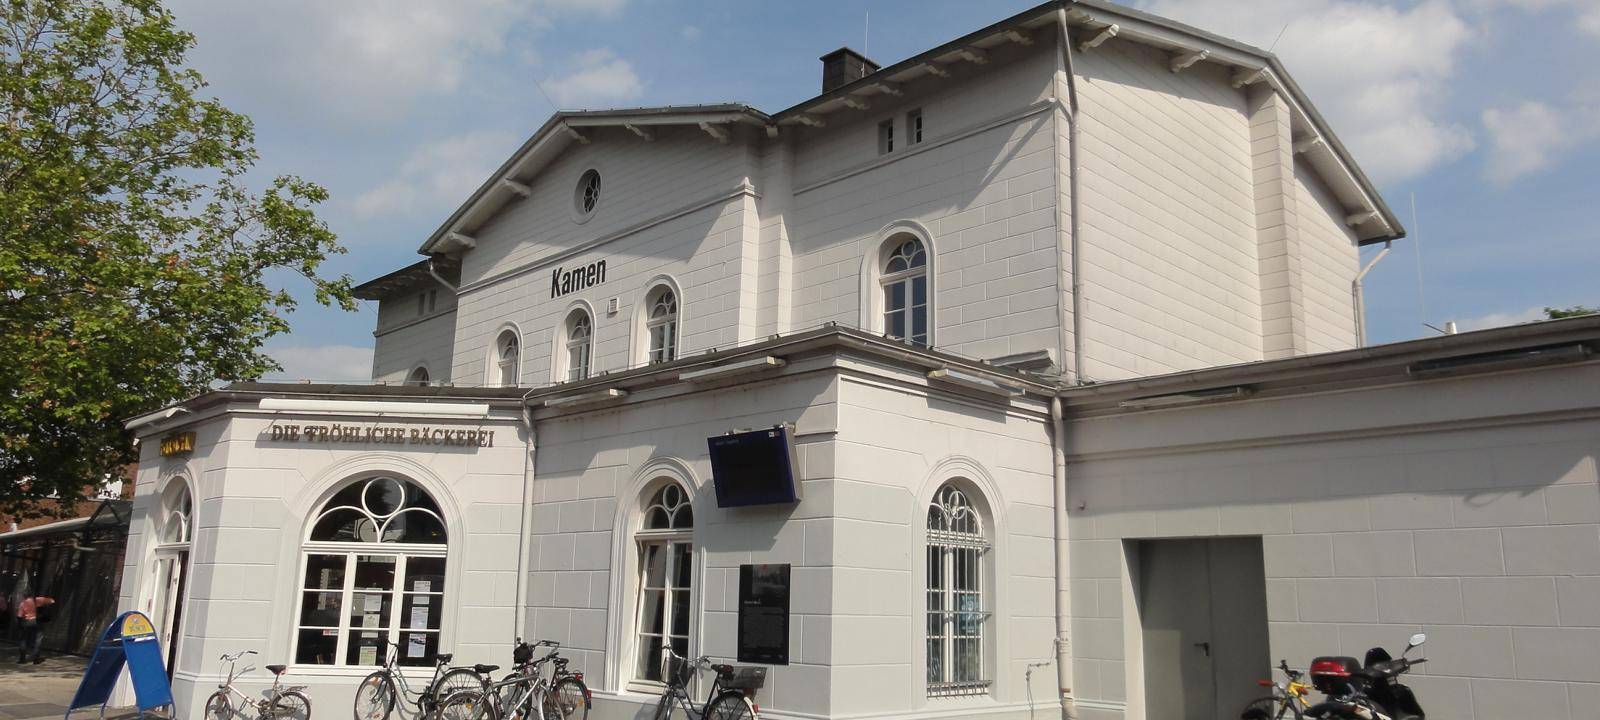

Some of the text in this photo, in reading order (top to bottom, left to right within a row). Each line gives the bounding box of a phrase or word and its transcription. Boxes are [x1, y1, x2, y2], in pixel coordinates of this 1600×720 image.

[551, 259, 606, 299] Kamen
[271, 424, 495, 447] DIE FRÖHLICHE BÄCKEREI
